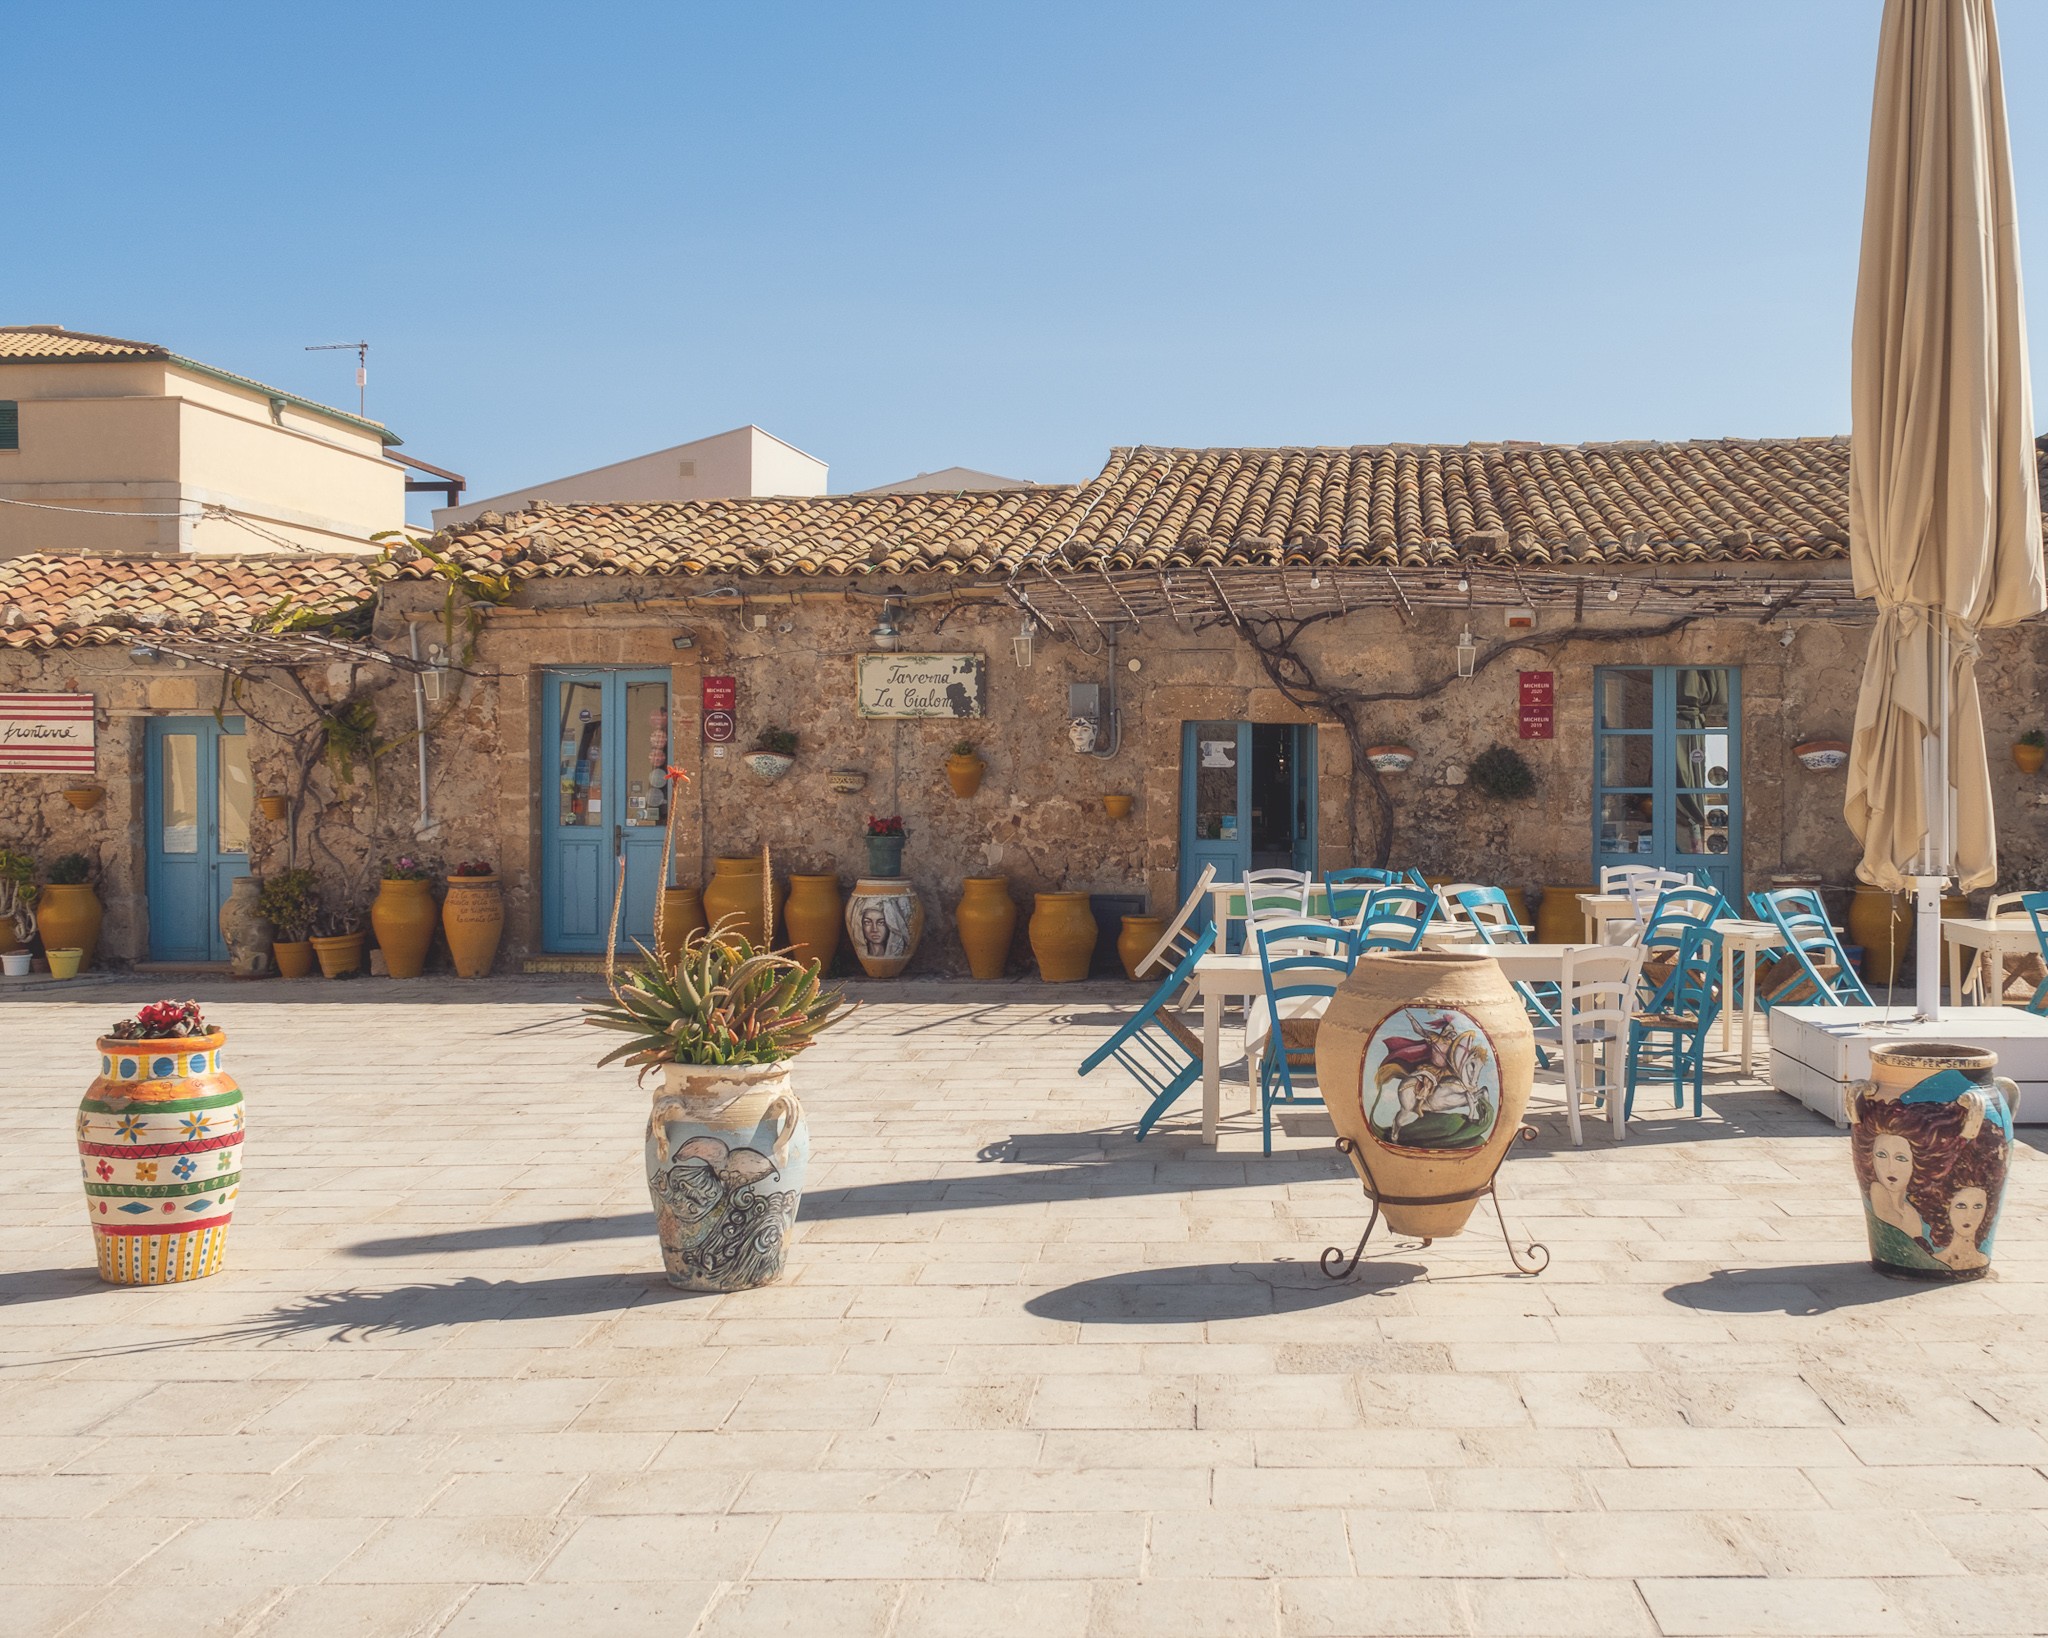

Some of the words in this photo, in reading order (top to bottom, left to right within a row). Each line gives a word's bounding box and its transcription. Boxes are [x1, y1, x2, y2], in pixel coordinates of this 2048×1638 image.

[887, 664, 951, 685] Taverna
[872, 687, 895, 708] La
[904, 687, 954, 708] Cialom
[1923, 1059, 1941, 1068] PER
[1946, 1059, 1982, 1068] SEMPRE
